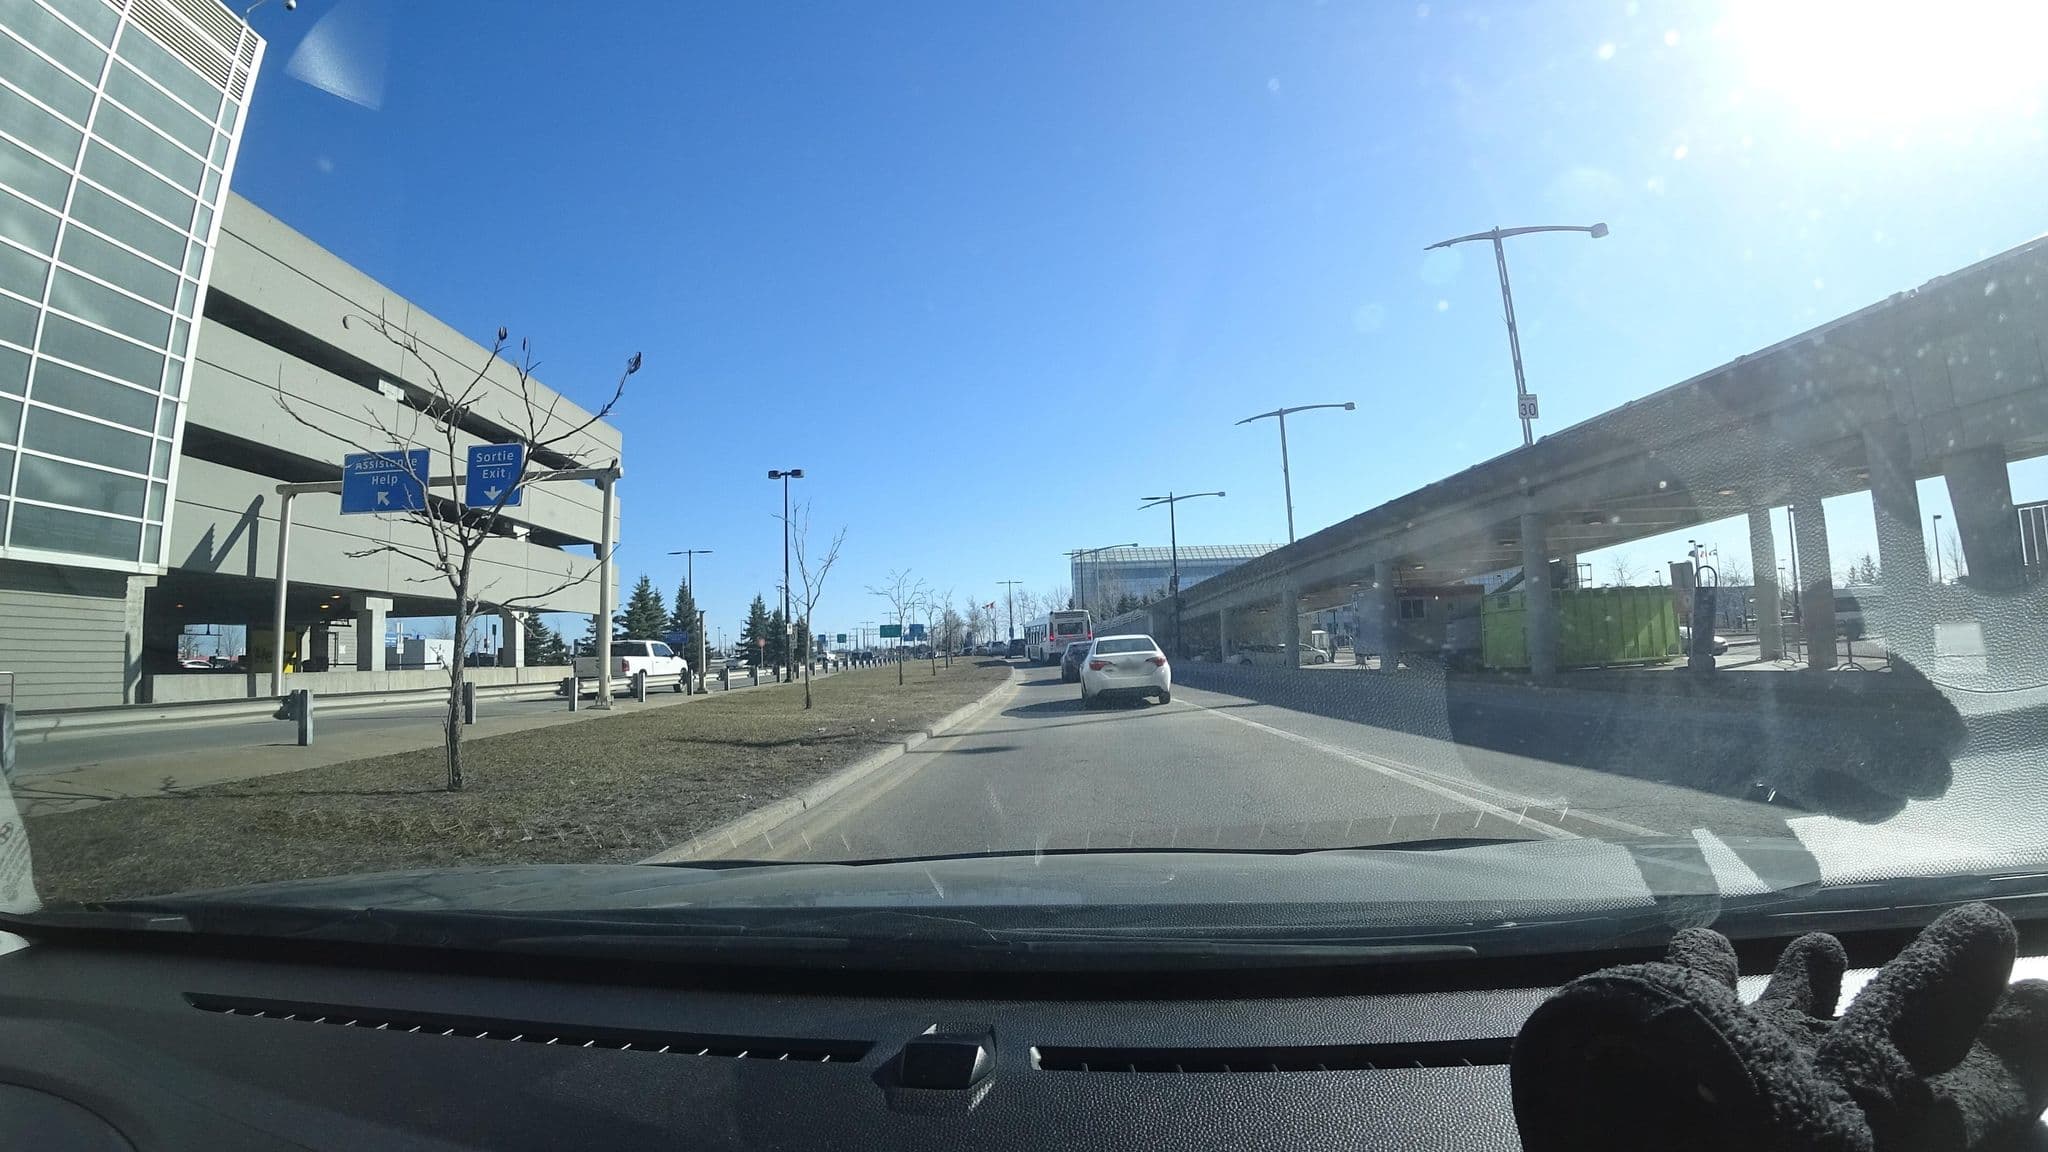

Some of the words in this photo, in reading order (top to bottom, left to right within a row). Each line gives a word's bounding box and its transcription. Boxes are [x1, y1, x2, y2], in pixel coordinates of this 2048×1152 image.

[1520, 403, 1537, 416] 30
[476, 450, 514, 463] Sortie
[355, 458, 417, 470] Assistane
[482, 467, 506, 479] Exit
[371, 474, 398, 487] Help
